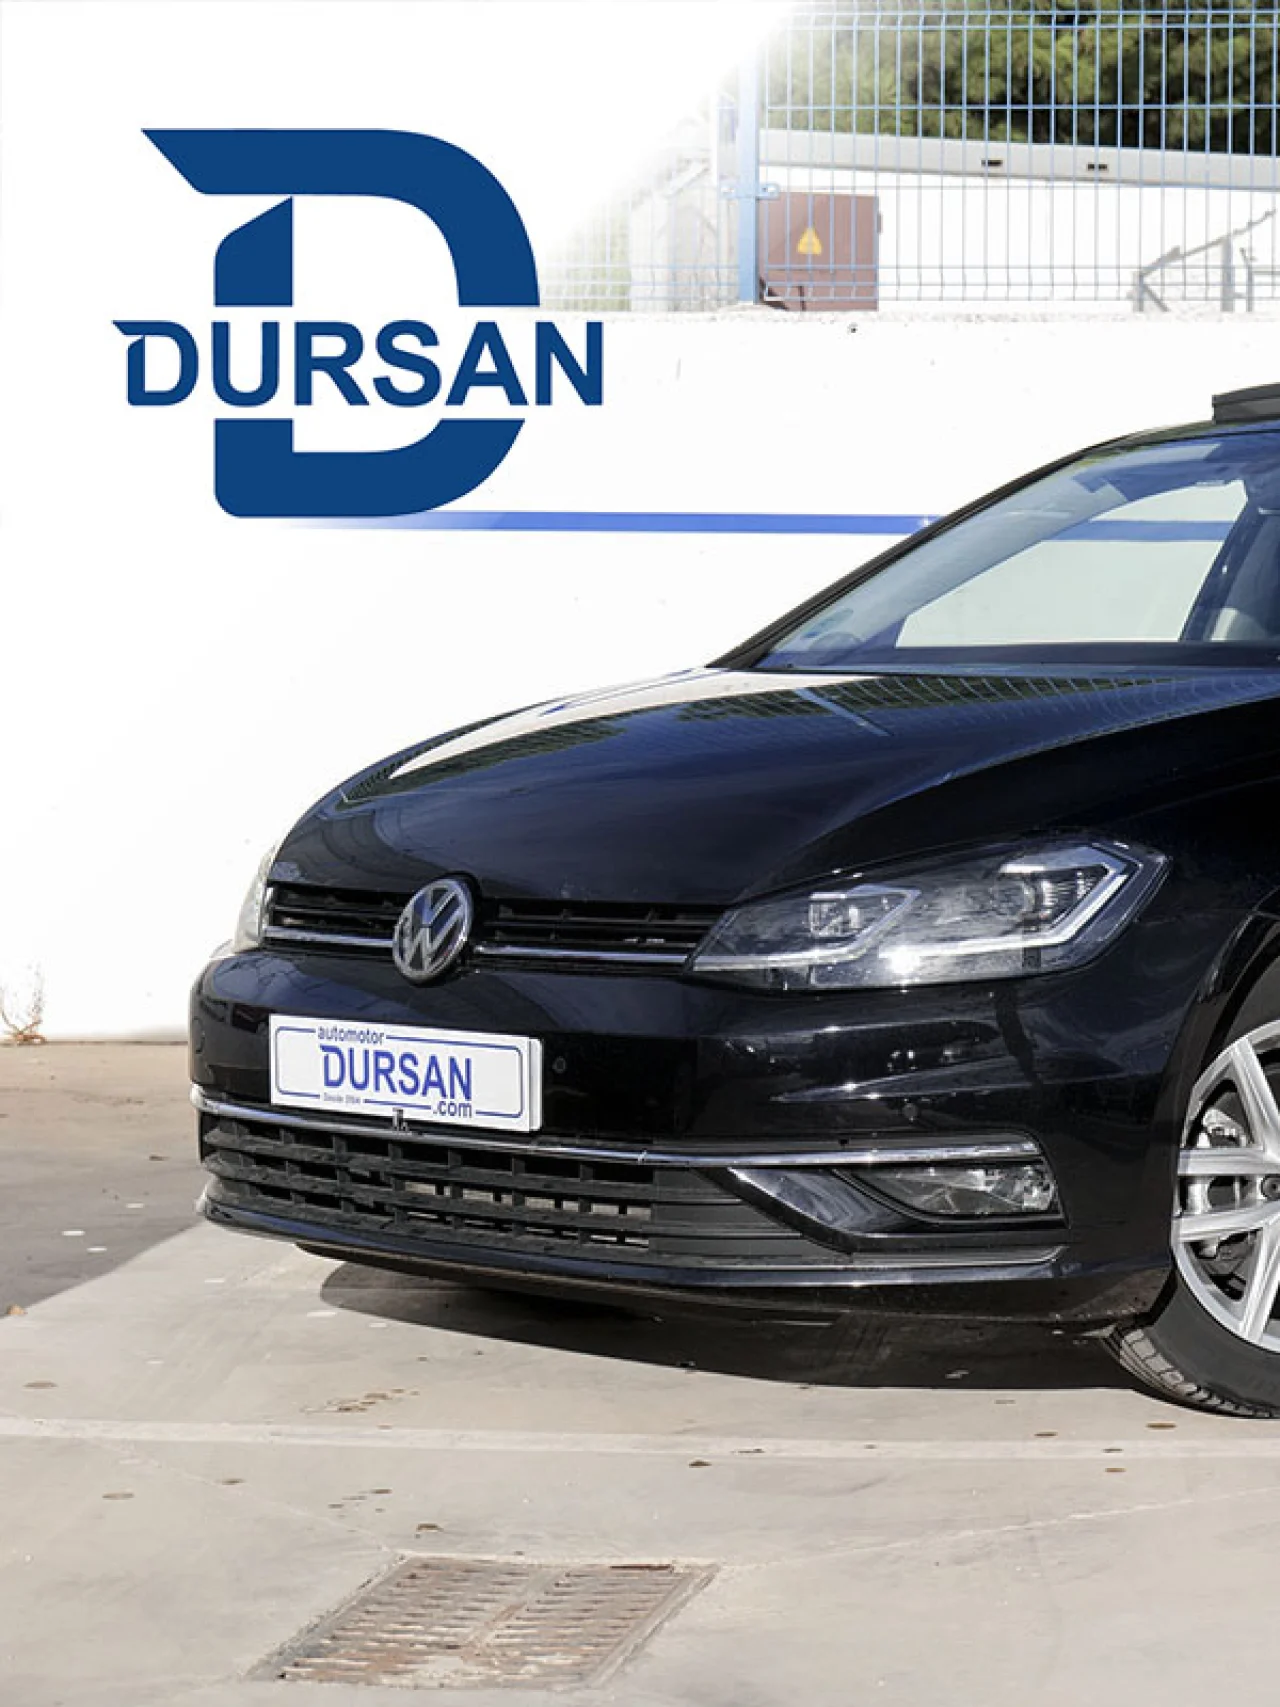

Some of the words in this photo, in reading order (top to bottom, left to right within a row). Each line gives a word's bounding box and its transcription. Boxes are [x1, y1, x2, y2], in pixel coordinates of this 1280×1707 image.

[317, 1025, 385, 1045] automotor
[319, 1044, 472, 1101] DURSAN
[432, 1099, 473, 1119] .com
